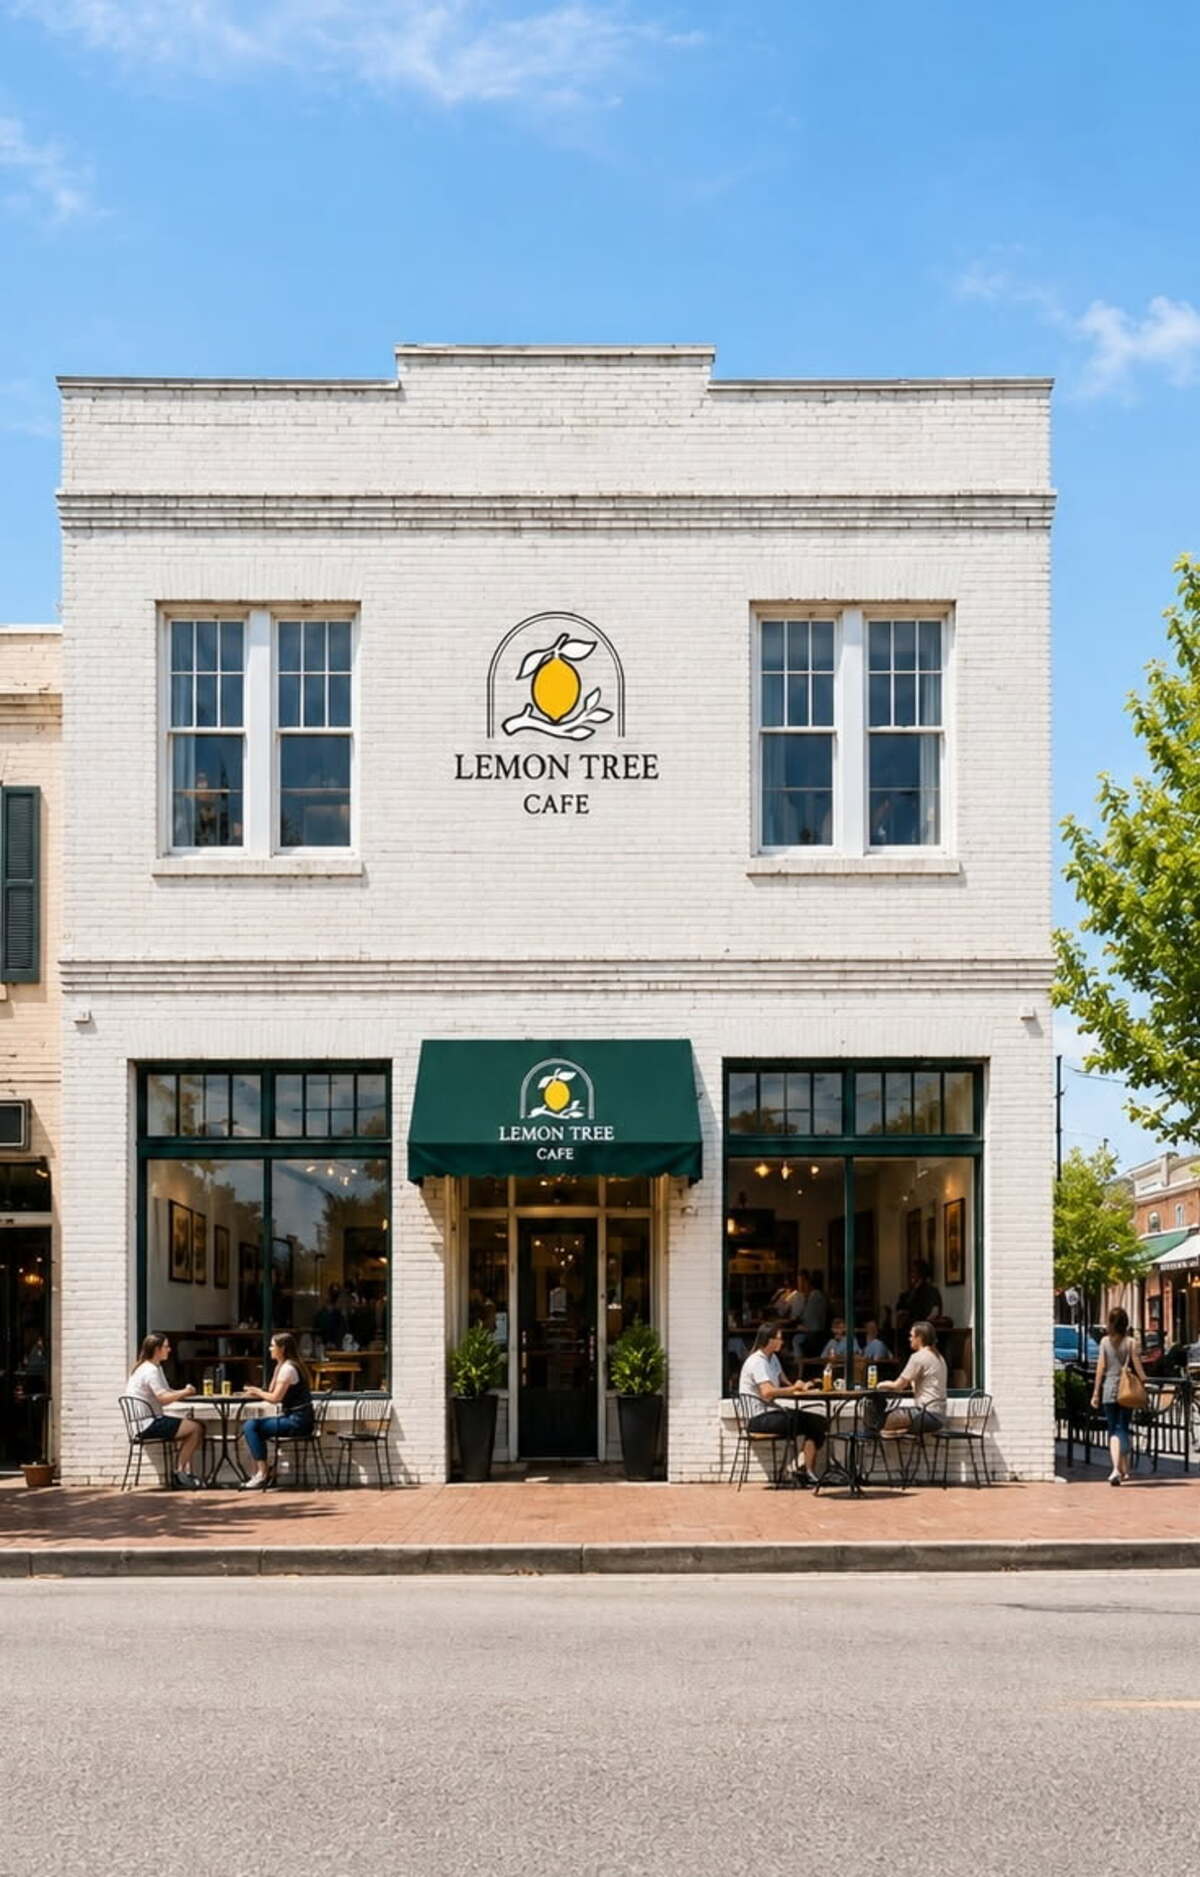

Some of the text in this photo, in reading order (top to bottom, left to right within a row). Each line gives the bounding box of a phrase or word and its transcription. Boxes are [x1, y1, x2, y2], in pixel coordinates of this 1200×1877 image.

[454, 753, 659, 780] LEMON TREE
[523, 793, 590, 815] CAFE
[499, 1125, 615, 1142] LEMON TREE
[536, 1147, 574, 1161] CAFE
